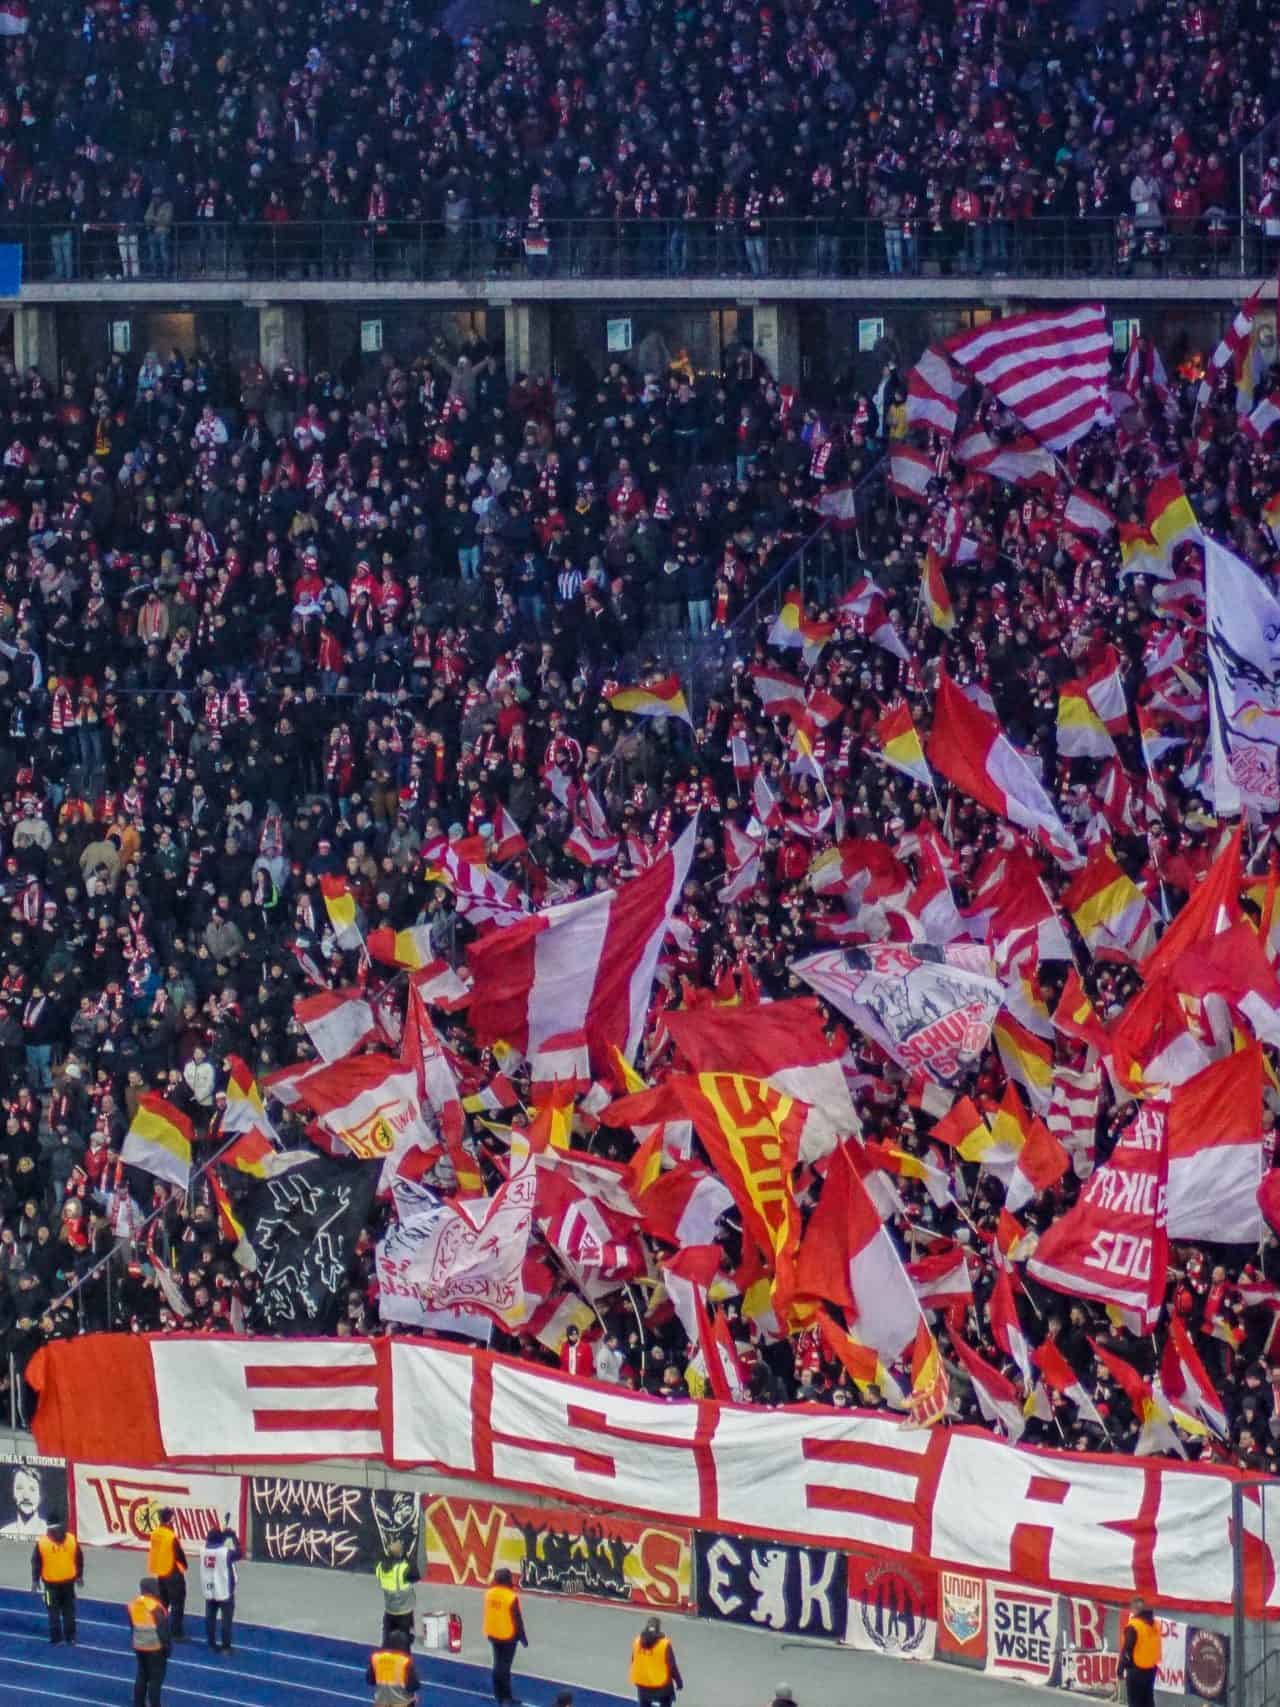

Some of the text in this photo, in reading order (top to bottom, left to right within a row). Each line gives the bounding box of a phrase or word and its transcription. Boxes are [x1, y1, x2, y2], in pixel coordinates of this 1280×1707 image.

[252, 1478, 362, 1525] HAMMER
[173, 1506, 221, 1541] NION
[265, 1522, 359, 1568] HEARTS
[798, 1551, 837, 1631] K
[943, 1574, 980, 1600] UNION
[994, 1601, 1051, 1638] SEK
[994, 1632, 1051, 1665] WSEE
